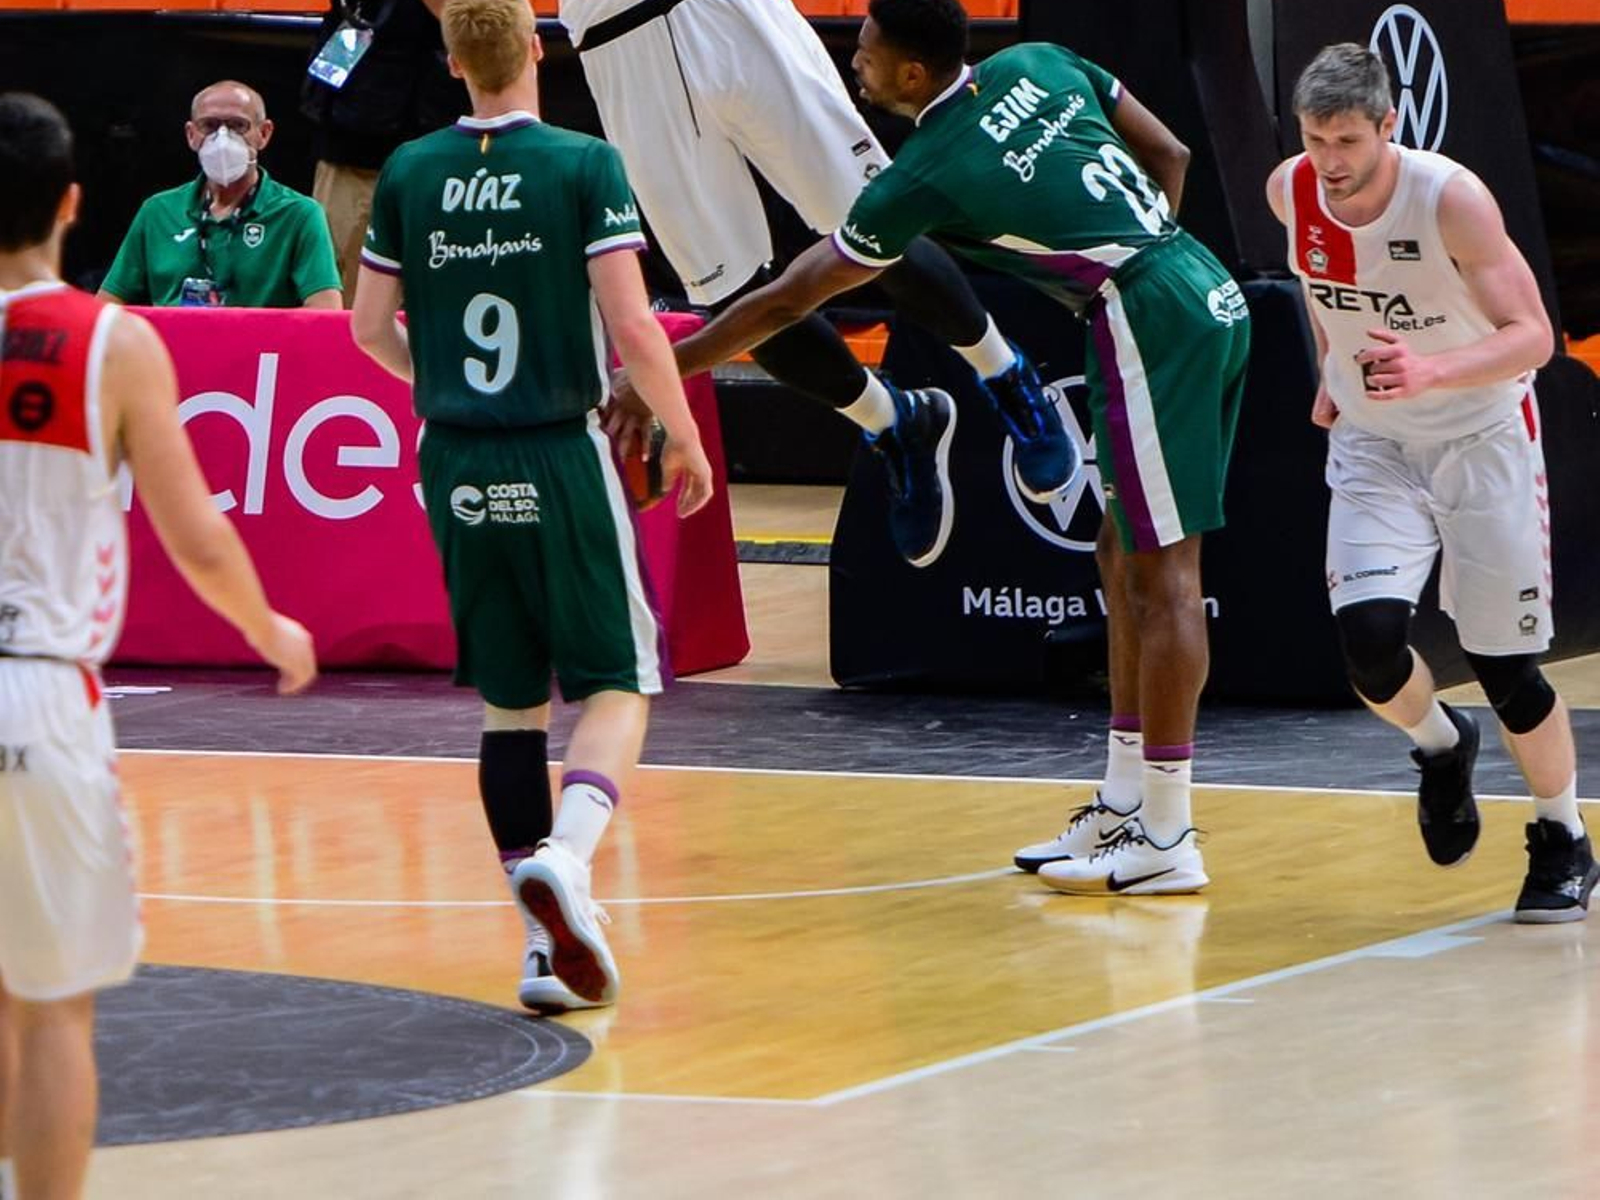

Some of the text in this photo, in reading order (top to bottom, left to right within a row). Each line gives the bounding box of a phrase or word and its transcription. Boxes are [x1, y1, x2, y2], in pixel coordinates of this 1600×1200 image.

[979, 77, 1049, 144] EJIM
[441, 167, 523, 212] DÍAZ
[1309, 283, 1414, 326] RETA
[1389, 313, 1447, 331] bet.es
[463, 293, 519, 394] 9
[486, 483, 539, 498] COSTA
[488, 499, 540, 511] DEL SOL
[962, 586, 1087, 625] Málaga
